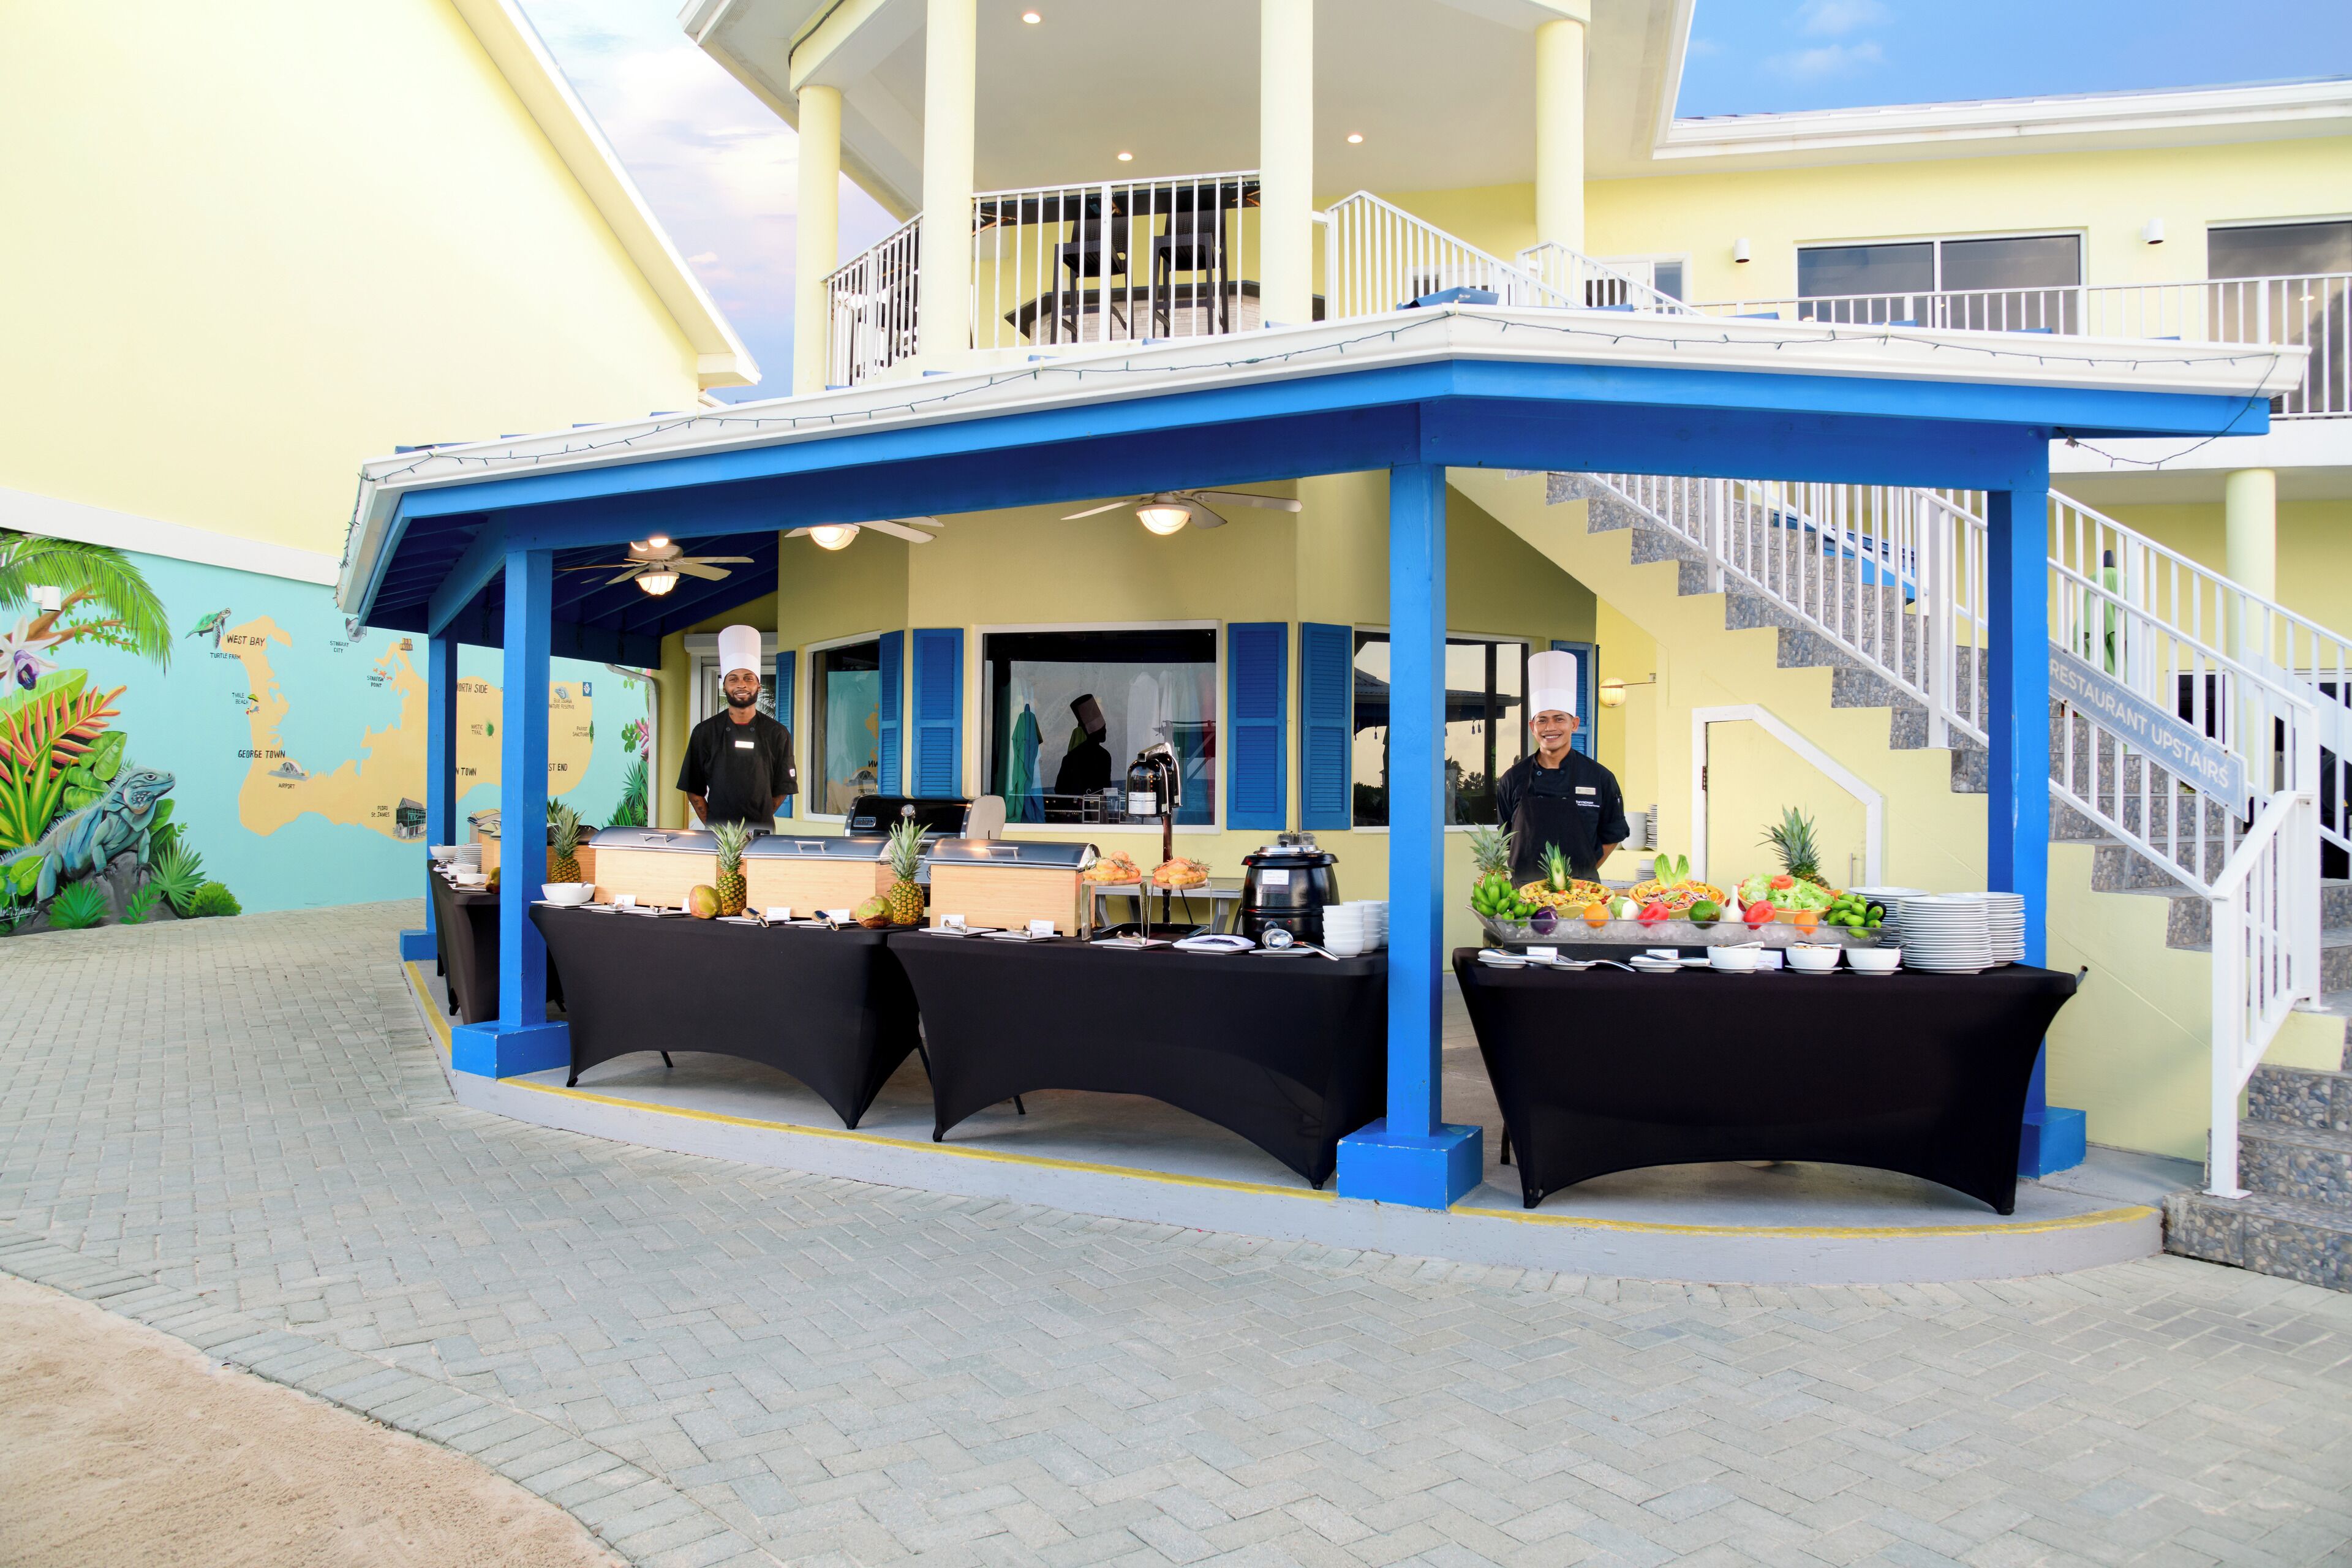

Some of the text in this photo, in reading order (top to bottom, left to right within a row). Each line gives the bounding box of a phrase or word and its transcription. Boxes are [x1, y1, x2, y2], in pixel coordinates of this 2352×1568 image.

[227, 634, 265, 646] WEST BAY
[458, 682, 472, 693] ORTH
[474, 684, 488, 693] SIDE
[2049, 658, 2230, 788] RESTAURANT UPSTAIRS
[238, 750, 285, 758] GEORGE TOWN
[461, 767, 477, 776] TOWN
